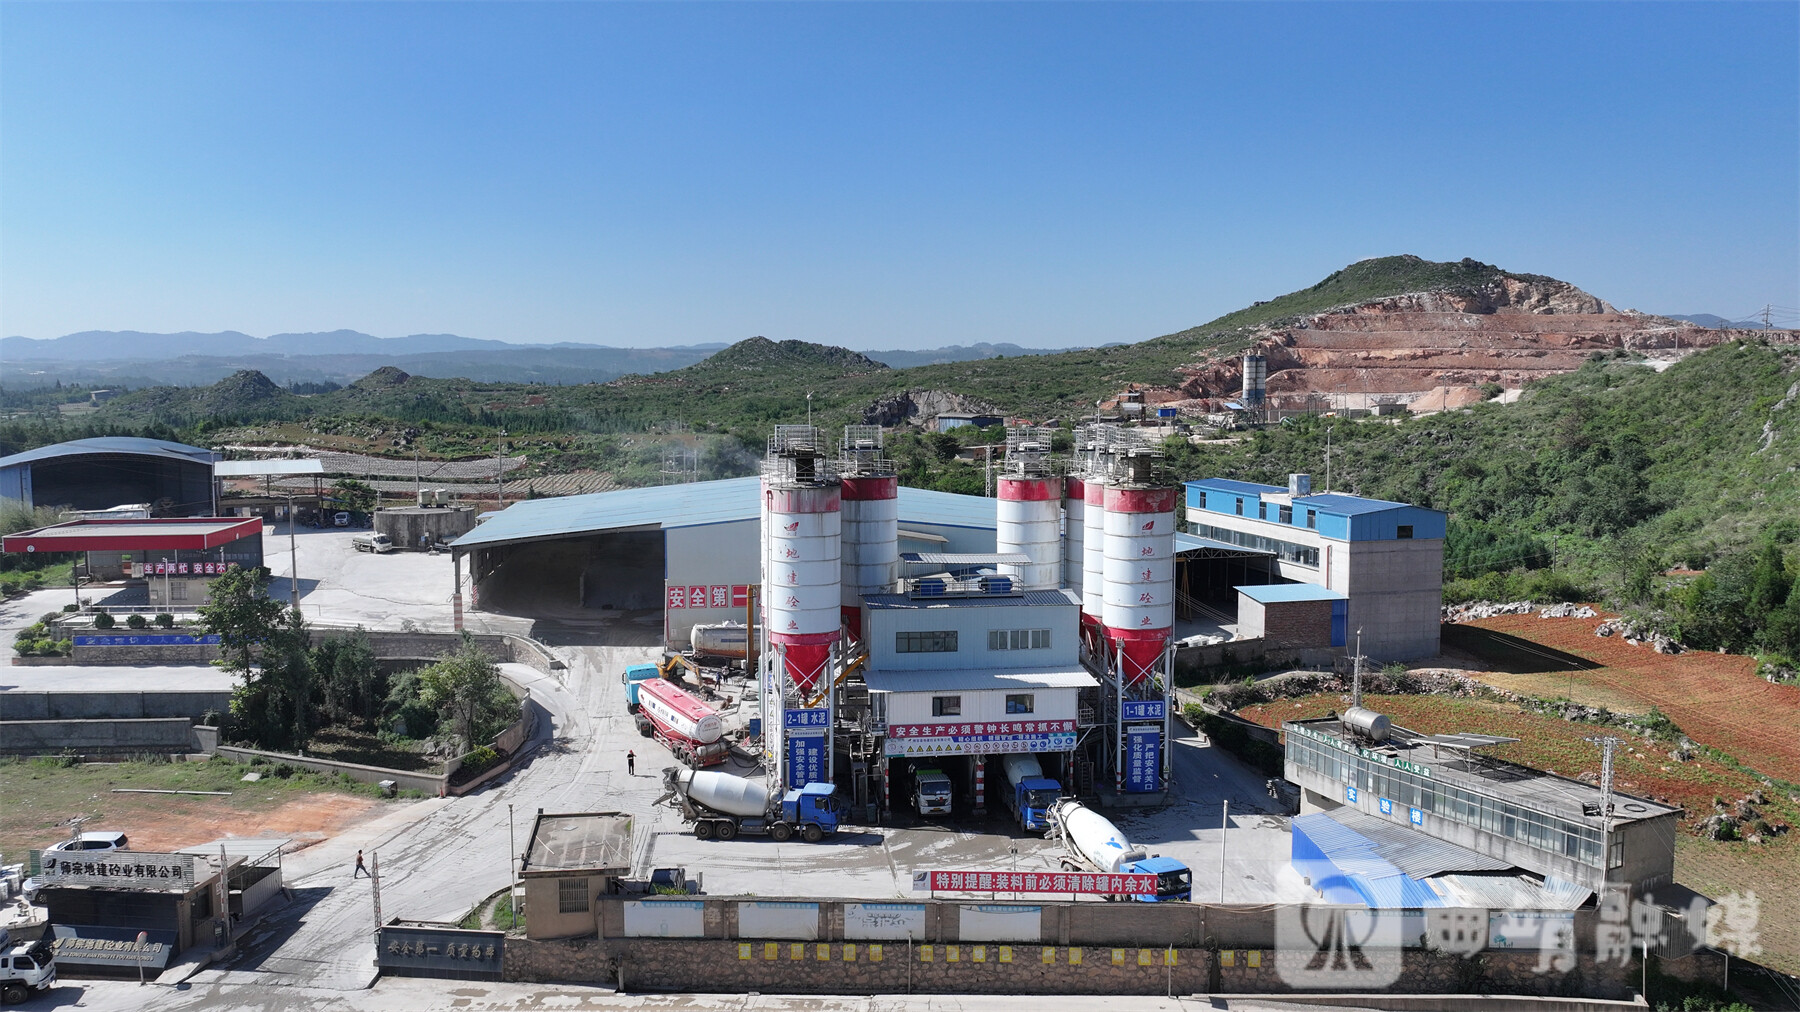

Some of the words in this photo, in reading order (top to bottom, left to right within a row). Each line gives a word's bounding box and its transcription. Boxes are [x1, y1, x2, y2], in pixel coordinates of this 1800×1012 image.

[193, 562, 236, 574] 安全不
[669, 587, 748, 608] 安全第一
[810, 712, 826, 724] 水泥
[1147, 704, 1162, 716] 水泥
[896, 721, 1073, 736] 安全生产必须警钟长鸣常抓不懈
[795, 740, 806, 787] 加强安全管理
[1132, 736, 1143, 783] 强化质量监督
[1144, 744, 1155, 790] 严把安全关口
[1348, 788, 1422, 824] 实验楼
[60, 861, 182, 879] 师宗地建砼业有限公司
[387, 940, 438, 955] 安全第一
